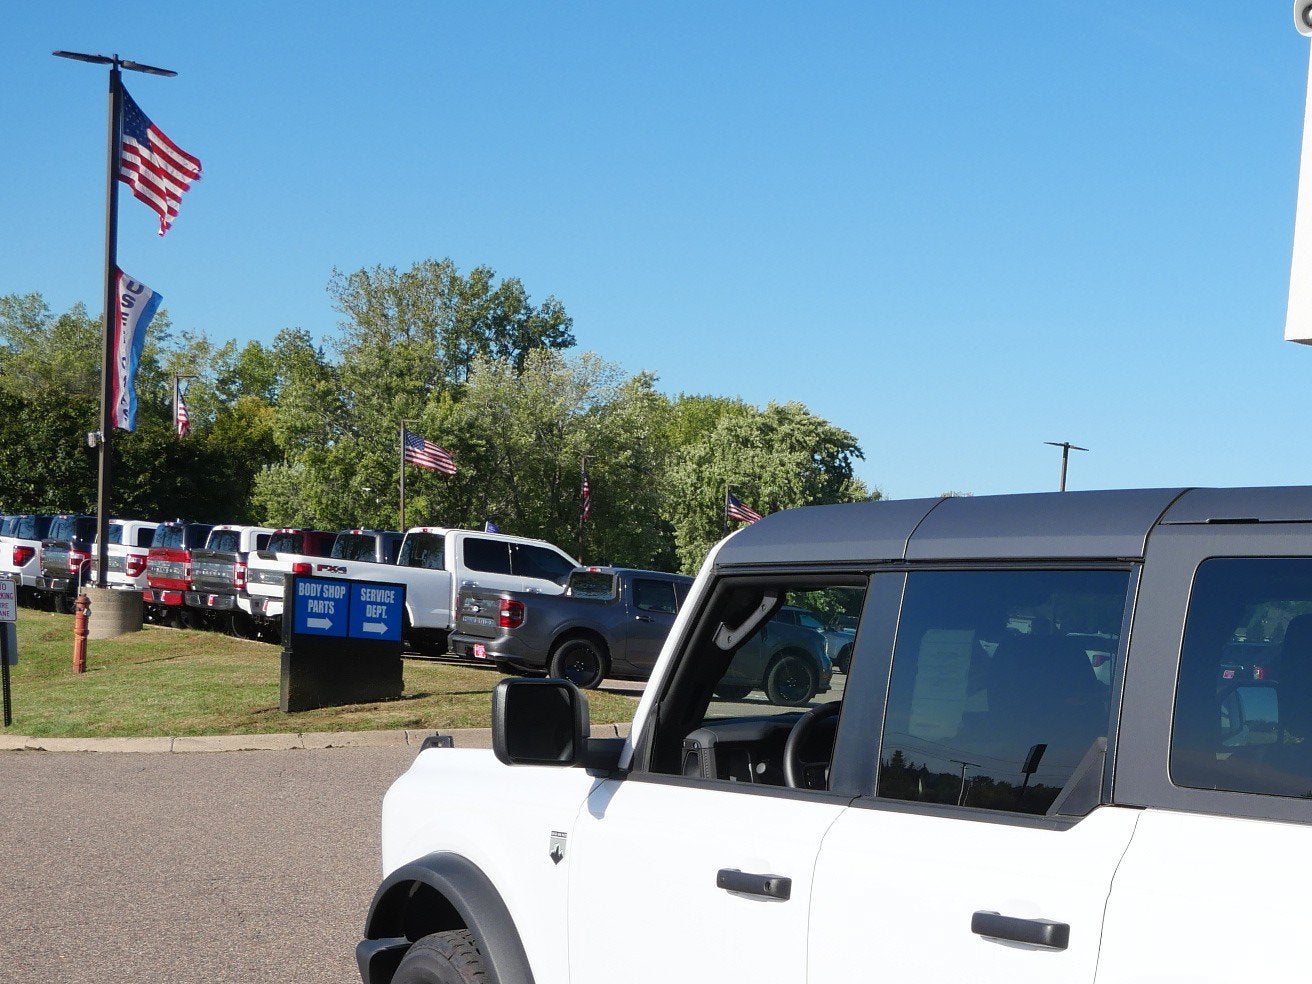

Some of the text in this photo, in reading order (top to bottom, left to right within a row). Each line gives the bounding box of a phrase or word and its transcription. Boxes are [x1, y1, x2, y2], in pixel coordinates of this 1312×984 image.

[316, 564, 347, 574] FX4
[298, 583, 346, 599] BODY SHOP
[360, 588, 395, 603] SERVICE
[307, 600, 335, 614] PARTS
[366, 605, 388, 619] DEPT.
